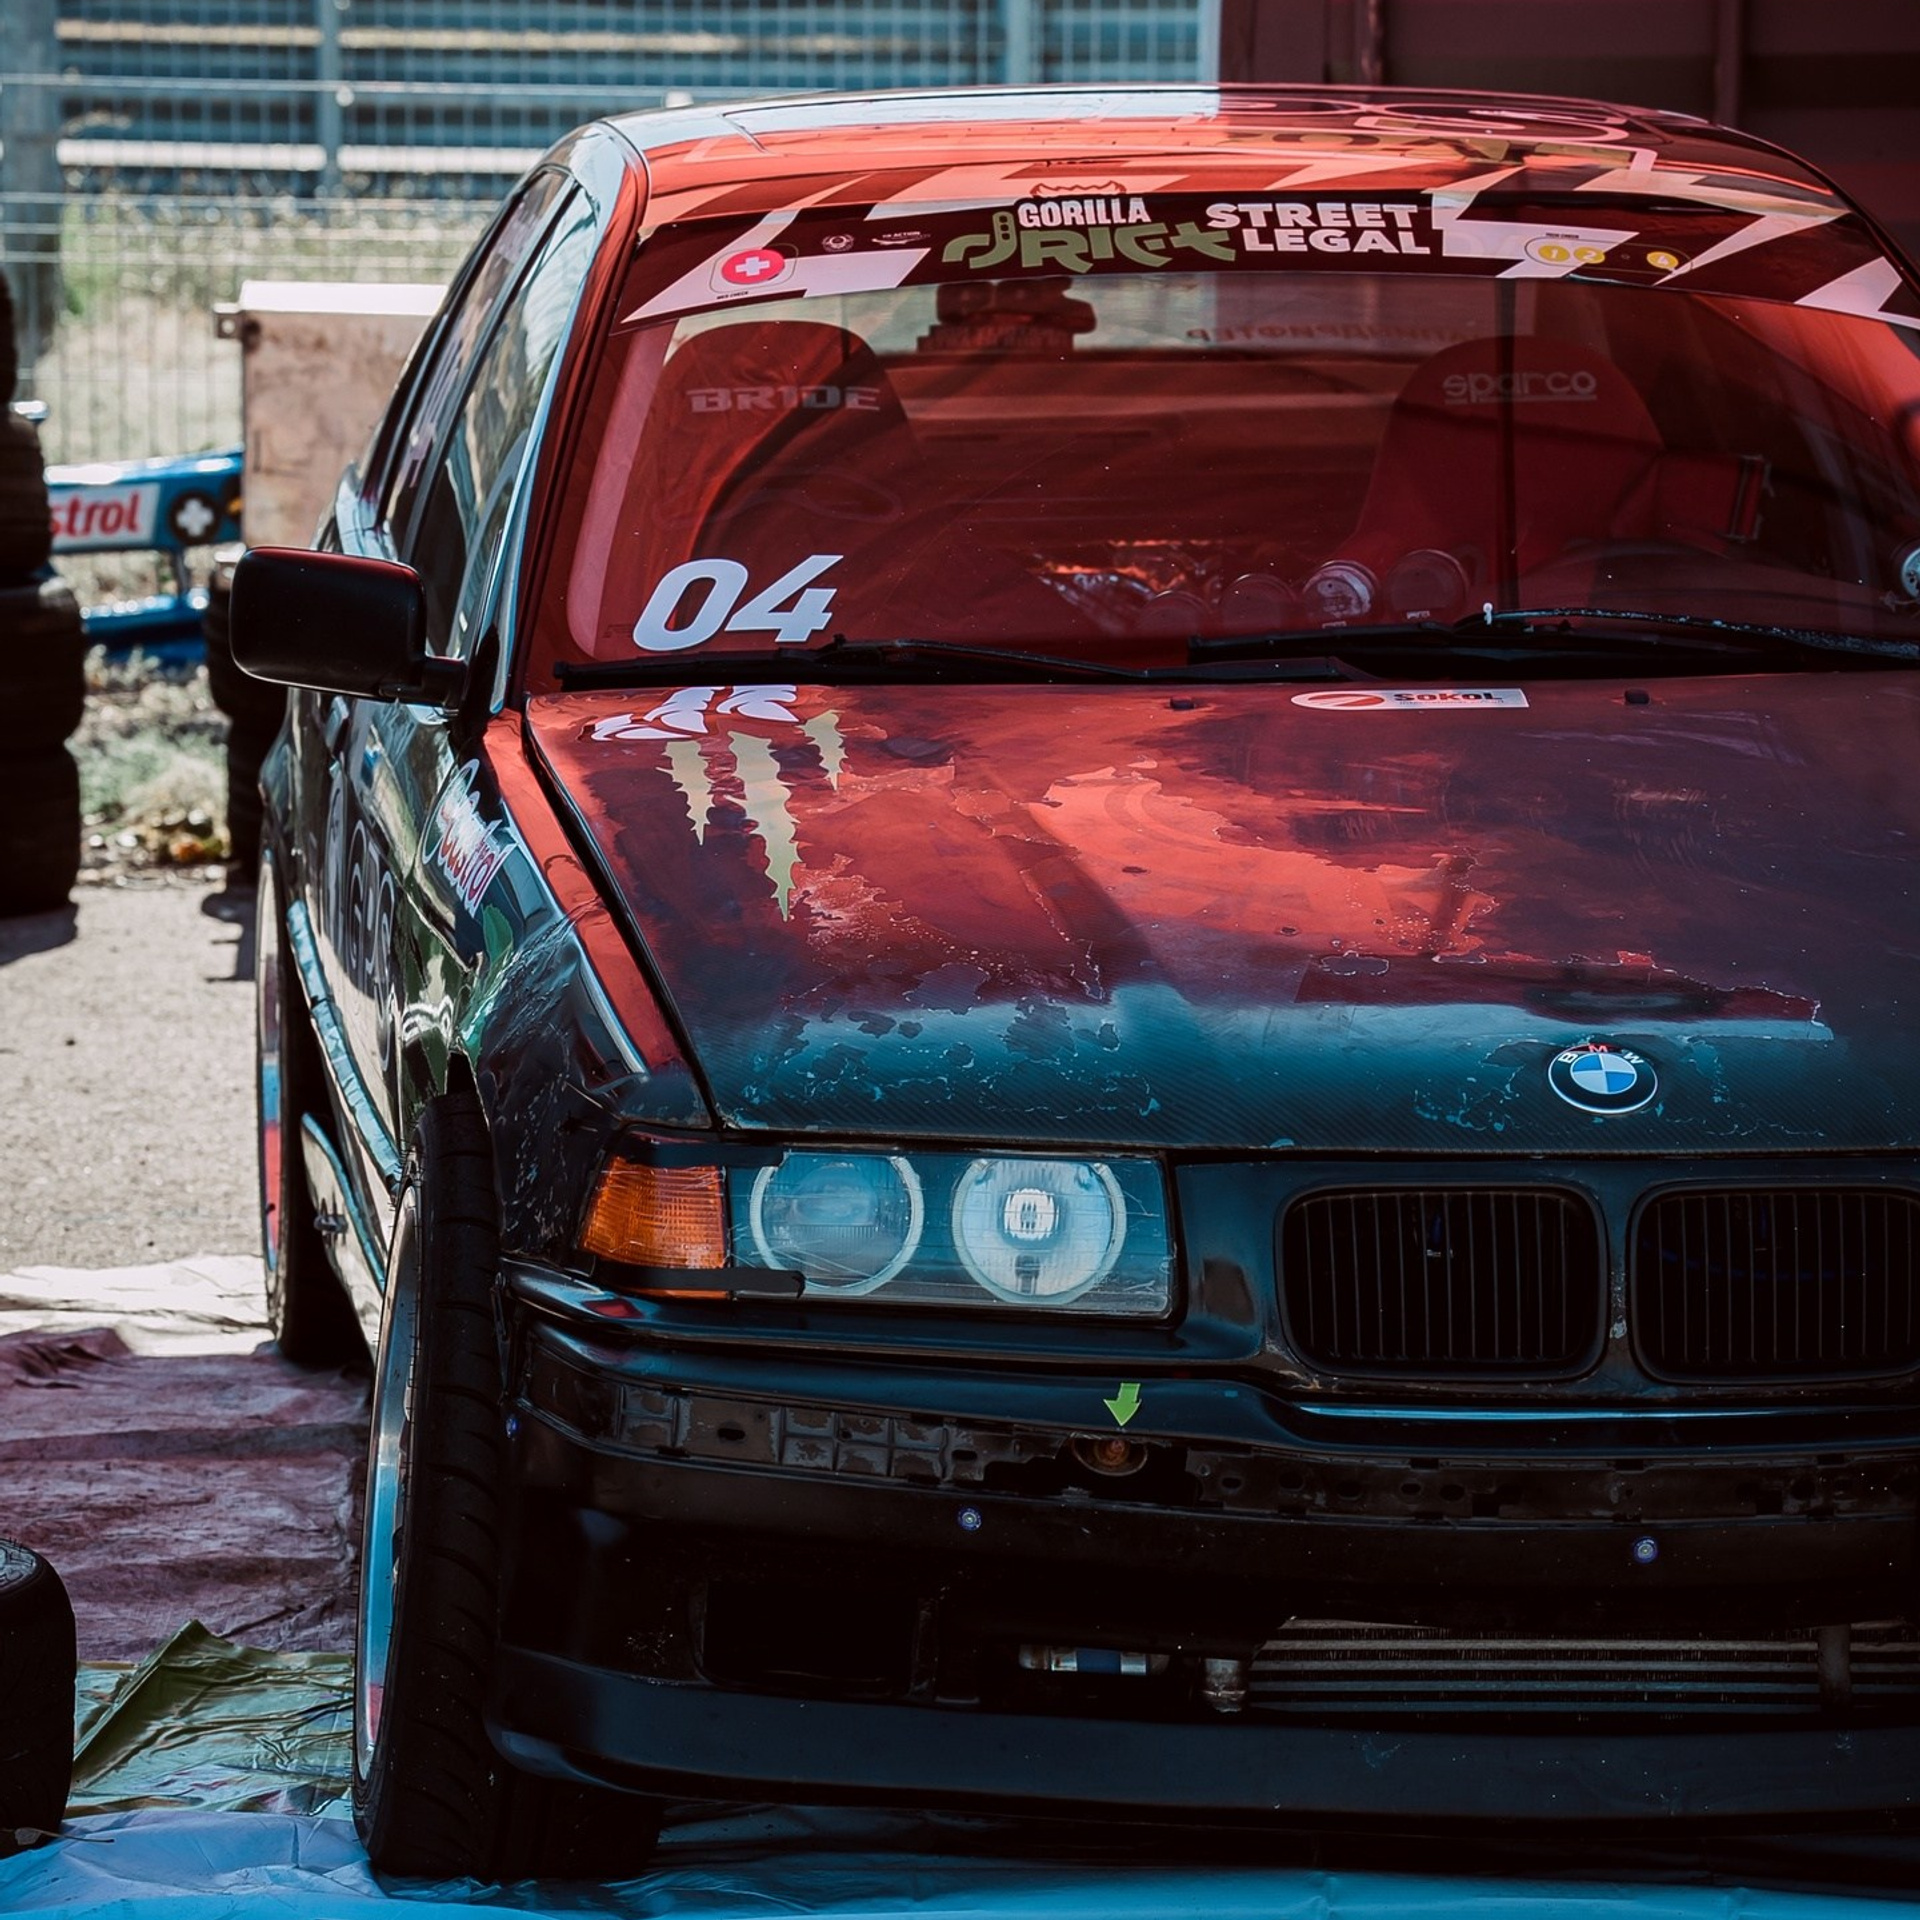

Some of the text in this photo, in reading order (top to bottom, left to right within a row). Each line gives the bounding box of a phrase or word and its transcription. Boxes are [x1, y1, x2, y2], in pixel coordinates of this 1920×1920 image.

[1017, 198, 1152, 228] GORILLA
[1205, 202, 1419, 229] STREET
[1242, 229, 1431, 255] LEGAL
[1583, 250, 1597, 260] 2
[1657, 255, 1670, 265] 4
[686, 385, 881, 413] BRIDE
[1443, 371, 1597, 404] sparco
[633, 554, 844, 651] 04
[1558, 1044, 1645, 1064] BMW
